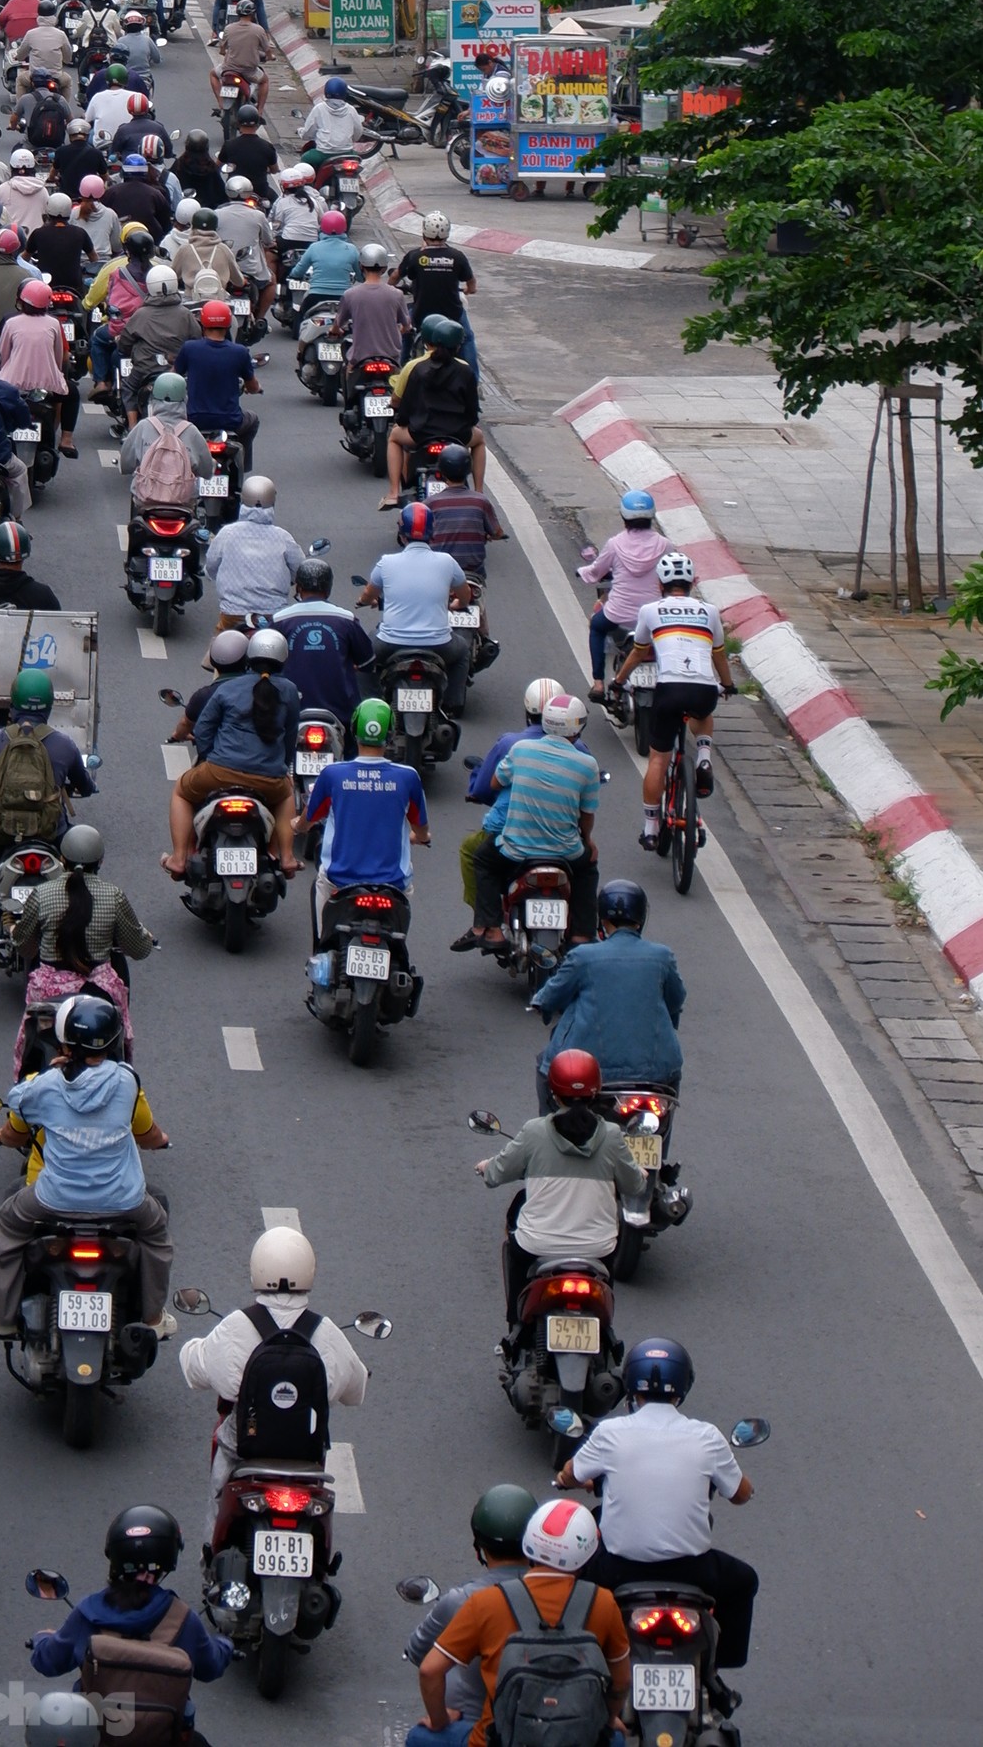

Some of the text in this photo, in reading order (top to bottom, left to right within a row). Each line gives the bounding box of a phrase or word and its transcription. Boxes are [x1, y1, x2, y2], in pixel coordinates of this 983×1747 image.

[334, 14, 390, 31] ĐẬU XANH
[500, 30, 514, 38] XE
[537, 77, 608, 95] CÔ NHUNG
[528, 134, 571, 149] BÁNH
[521, 152, 541, 167] XÔI
[544, 152, 573, 170] THẬP
[200, 486, 227, 496] 053.65
[153, 569, 180, 580] 108.31
[657, 607, 708, 616] BORA
[24, 634, 56, 666] 54
[403, 690, 427, 700] 72-C1
[399, 700, 430, 711] 399.43
[357, 769, 382, 780] ĐẠI HỌC
[342, 779, 397, 792] CÔNG NGHỆ SÀI GÒN
[219, 862, 254, 874] 601.38
[531, 902, 560, 914] 62-X1
[532, 914, 560, 927] 4497
[354, 949, 384, 964] 59-D3
[350, 962, 386, 978] 083.50
[625, 1136, 655, 1152] 9-N2
[634, 1152, 658, 1167] 3.30
[67, 1294, 104, 1311] 59-S3
[63, 1310, 108, 1328] 131.08
[555, 1318, 590, 1335] 54-N1
[554, 1334, 592, 1351] 4707
[264, 1535, 303, 1554] 81-B1
[258, 1554, 309, 1573] 996.53
[643, 1668, 685, 1688] 86-B2
[637, 1689, 691, 1708] 253.17
